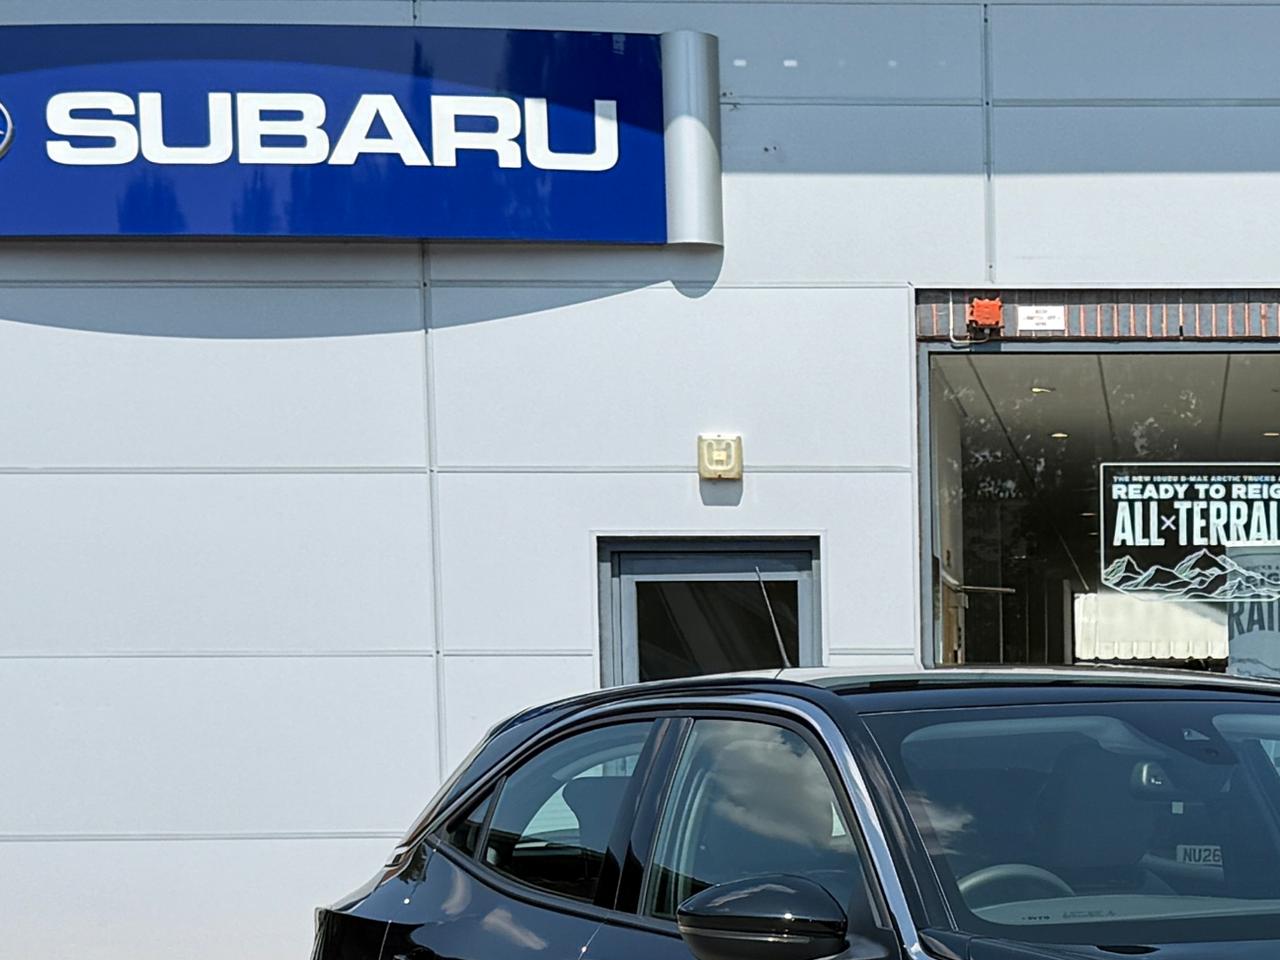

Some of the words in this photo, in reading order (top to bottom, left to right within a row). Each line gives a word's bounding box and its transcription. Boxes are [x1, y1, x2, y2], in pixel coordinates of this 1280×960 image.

[46, 91, 619, 172] SUBARU
[1112, 484, 1189, 499] READY
[1194, 484, 1226, 499] TO
[1113, 501, 1165, 546] ALL
[1183, 848, 1221, 862] NU26
